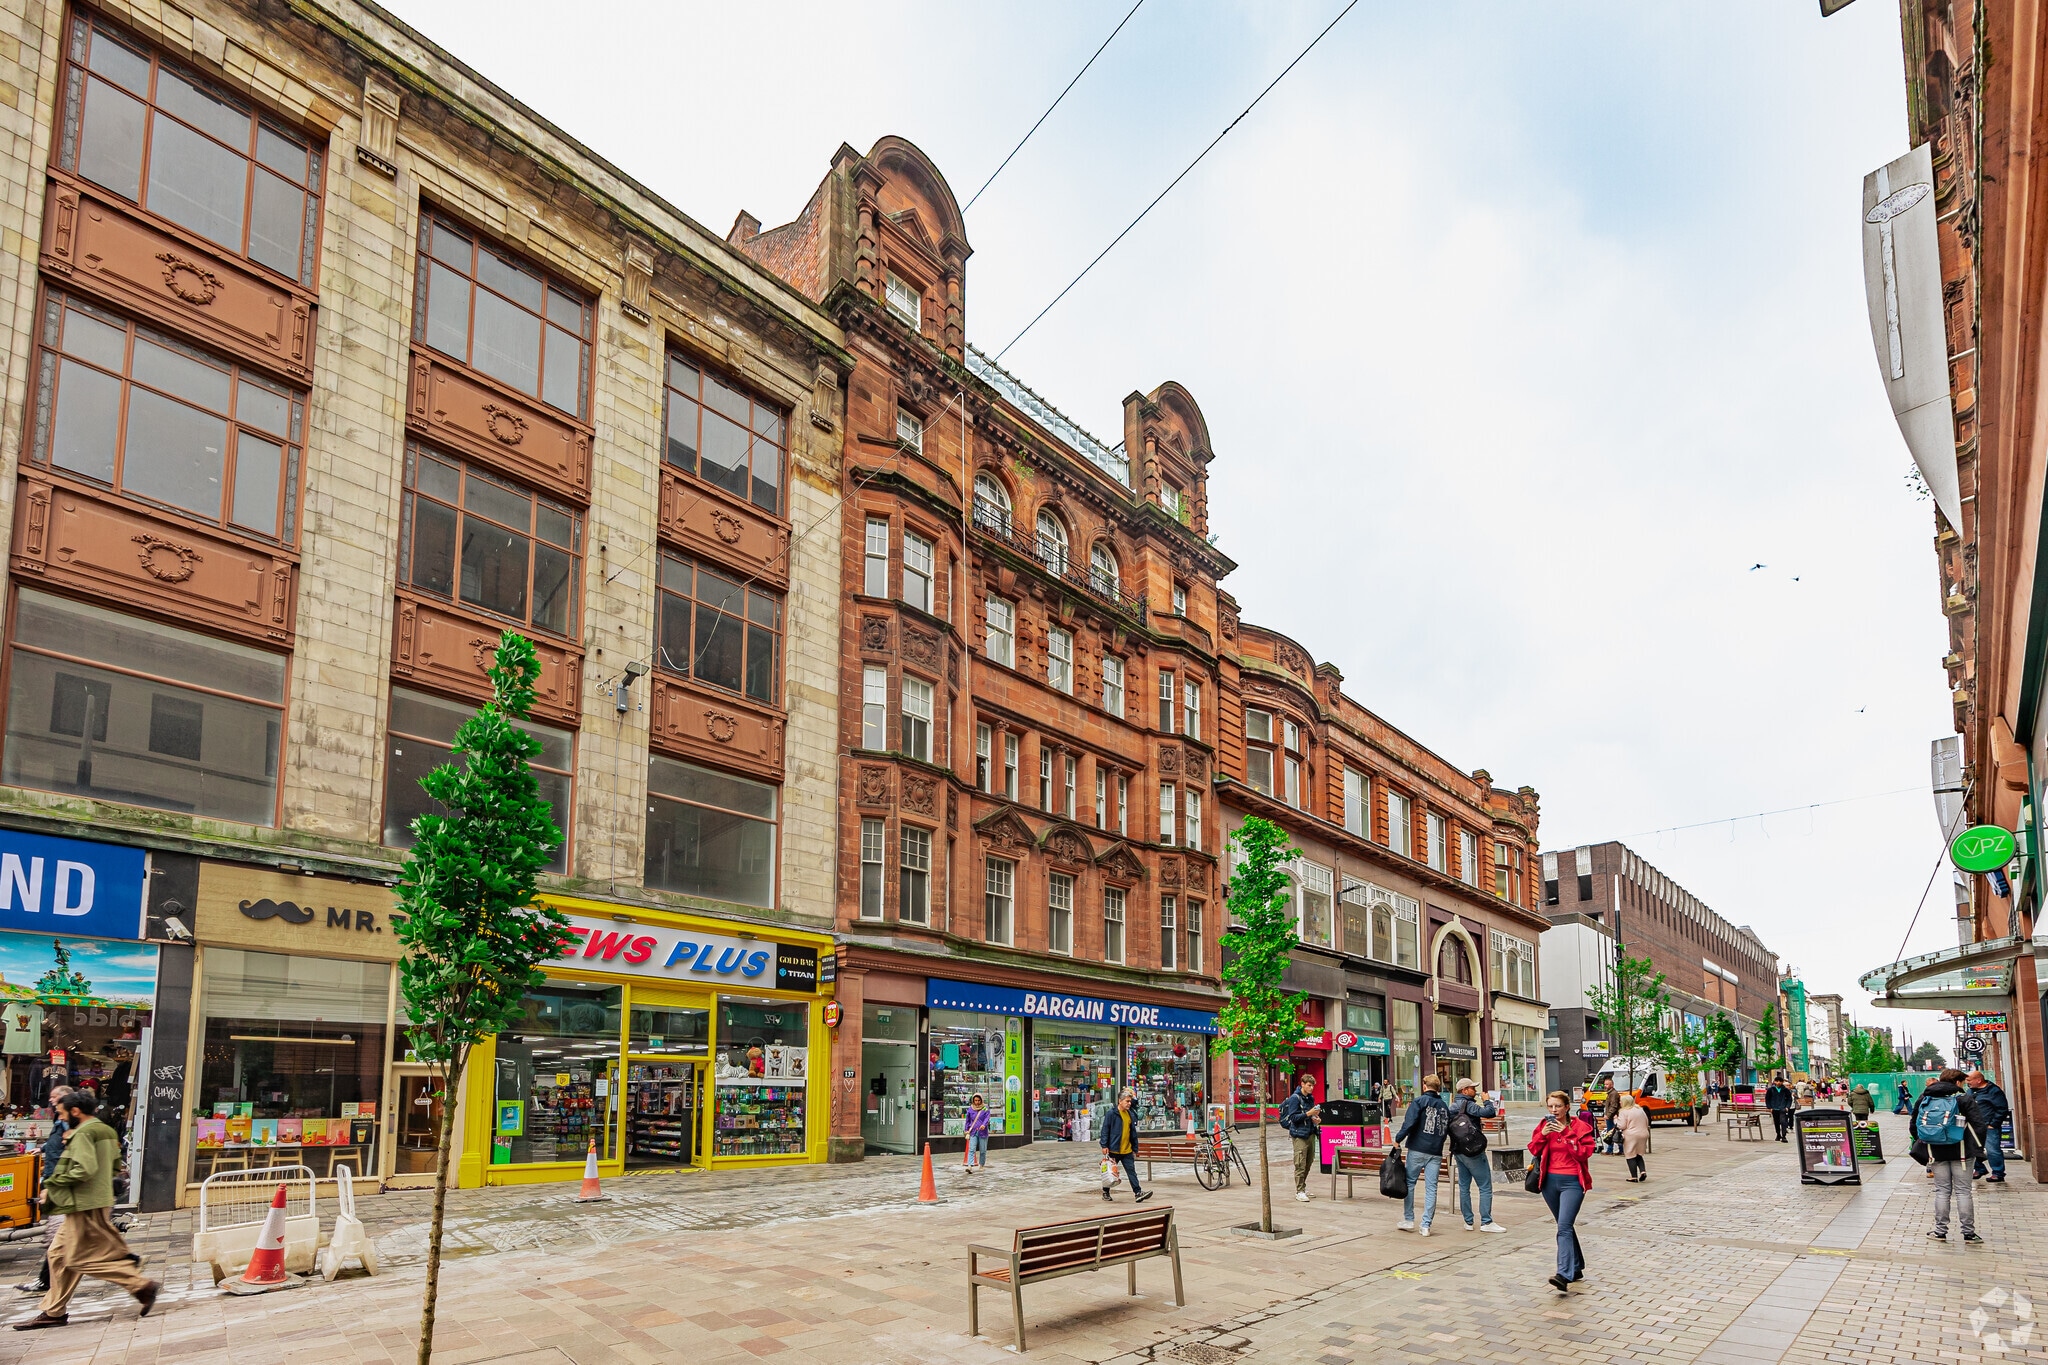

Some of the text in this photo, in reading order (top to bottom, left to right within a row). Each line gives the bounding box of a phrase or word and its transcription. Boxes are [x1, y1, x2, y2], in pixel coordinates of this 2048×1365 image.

[1962, 835, 2008, 856] VPZ
[326, 906, 382, 933] MR.
[664, 940, 771, 978] PLUS
[779, 955, 799, 965] GOLD
[800, 958, 814, 967] BAR
[787, 969, 815, 979] TITAN
[827, 1010, 837, 1019] 24
[1023, 993, 1160, 1026] BARGAIN STORE
[1433, 1042, 1444, 1051] W
[1448, 1046, 1475, 1057] WATERSTONES
